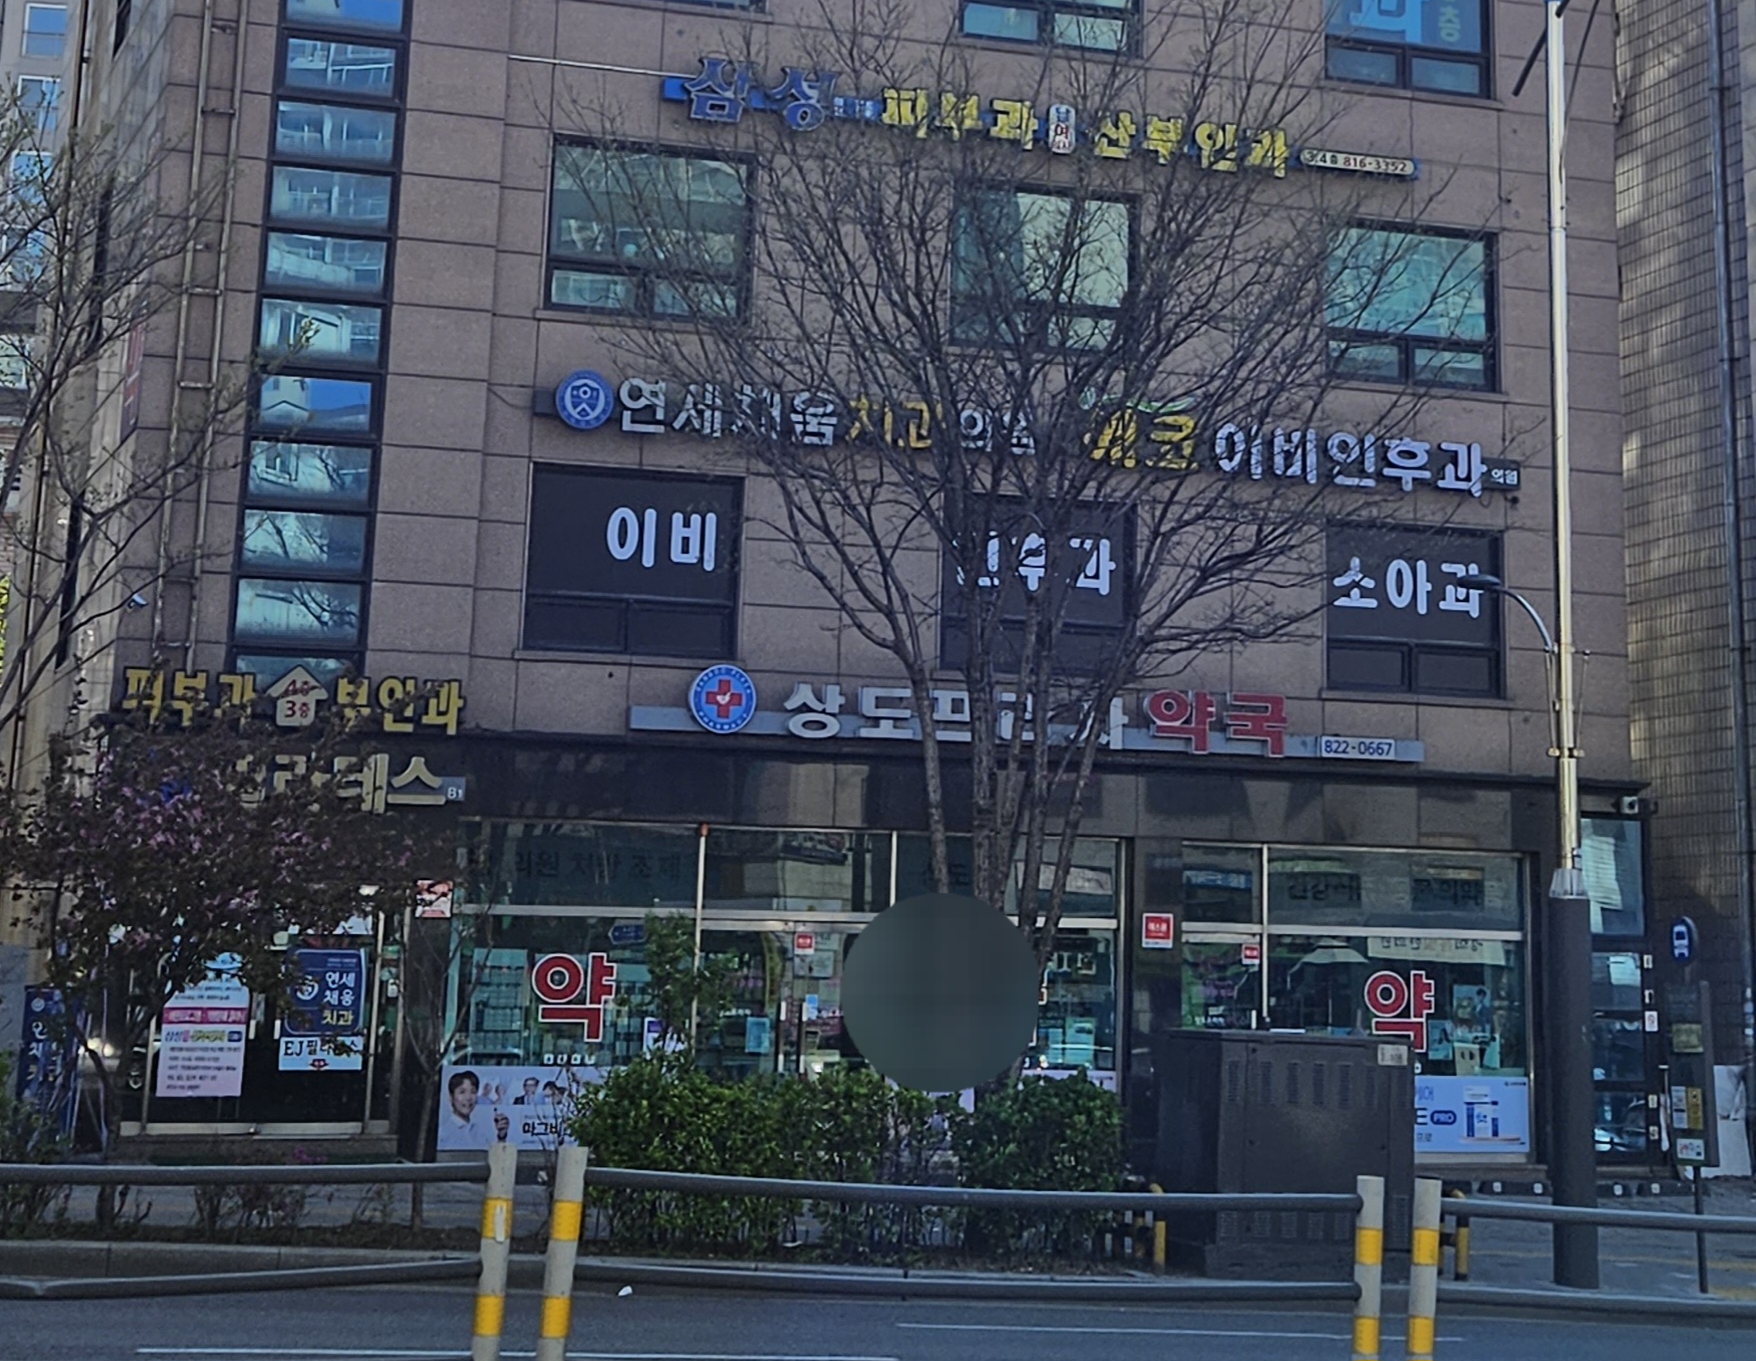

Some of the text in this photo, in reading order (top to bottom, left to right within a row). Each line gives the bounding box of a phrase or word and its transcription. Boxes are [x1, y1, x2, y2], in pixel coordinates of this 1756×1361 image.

[683, 56, 840, 132] 삼성
[1343, 155, 1408, 173] 816-3352
[606, 506, 718, 572] 이비
[1333, 556, 1484, 619] 소아과
[284, 700, 311, 719] 3층
[1146, 689, 1288, 757] 약국
[1323, 739, 1393, 757] 822-0667
[325, 971, 356, 988] 연세
[532, 952, 617, 1043] 약
[1364, 970, 1435, 1053] 약
[321, 1009, 354, 1026] 치과
